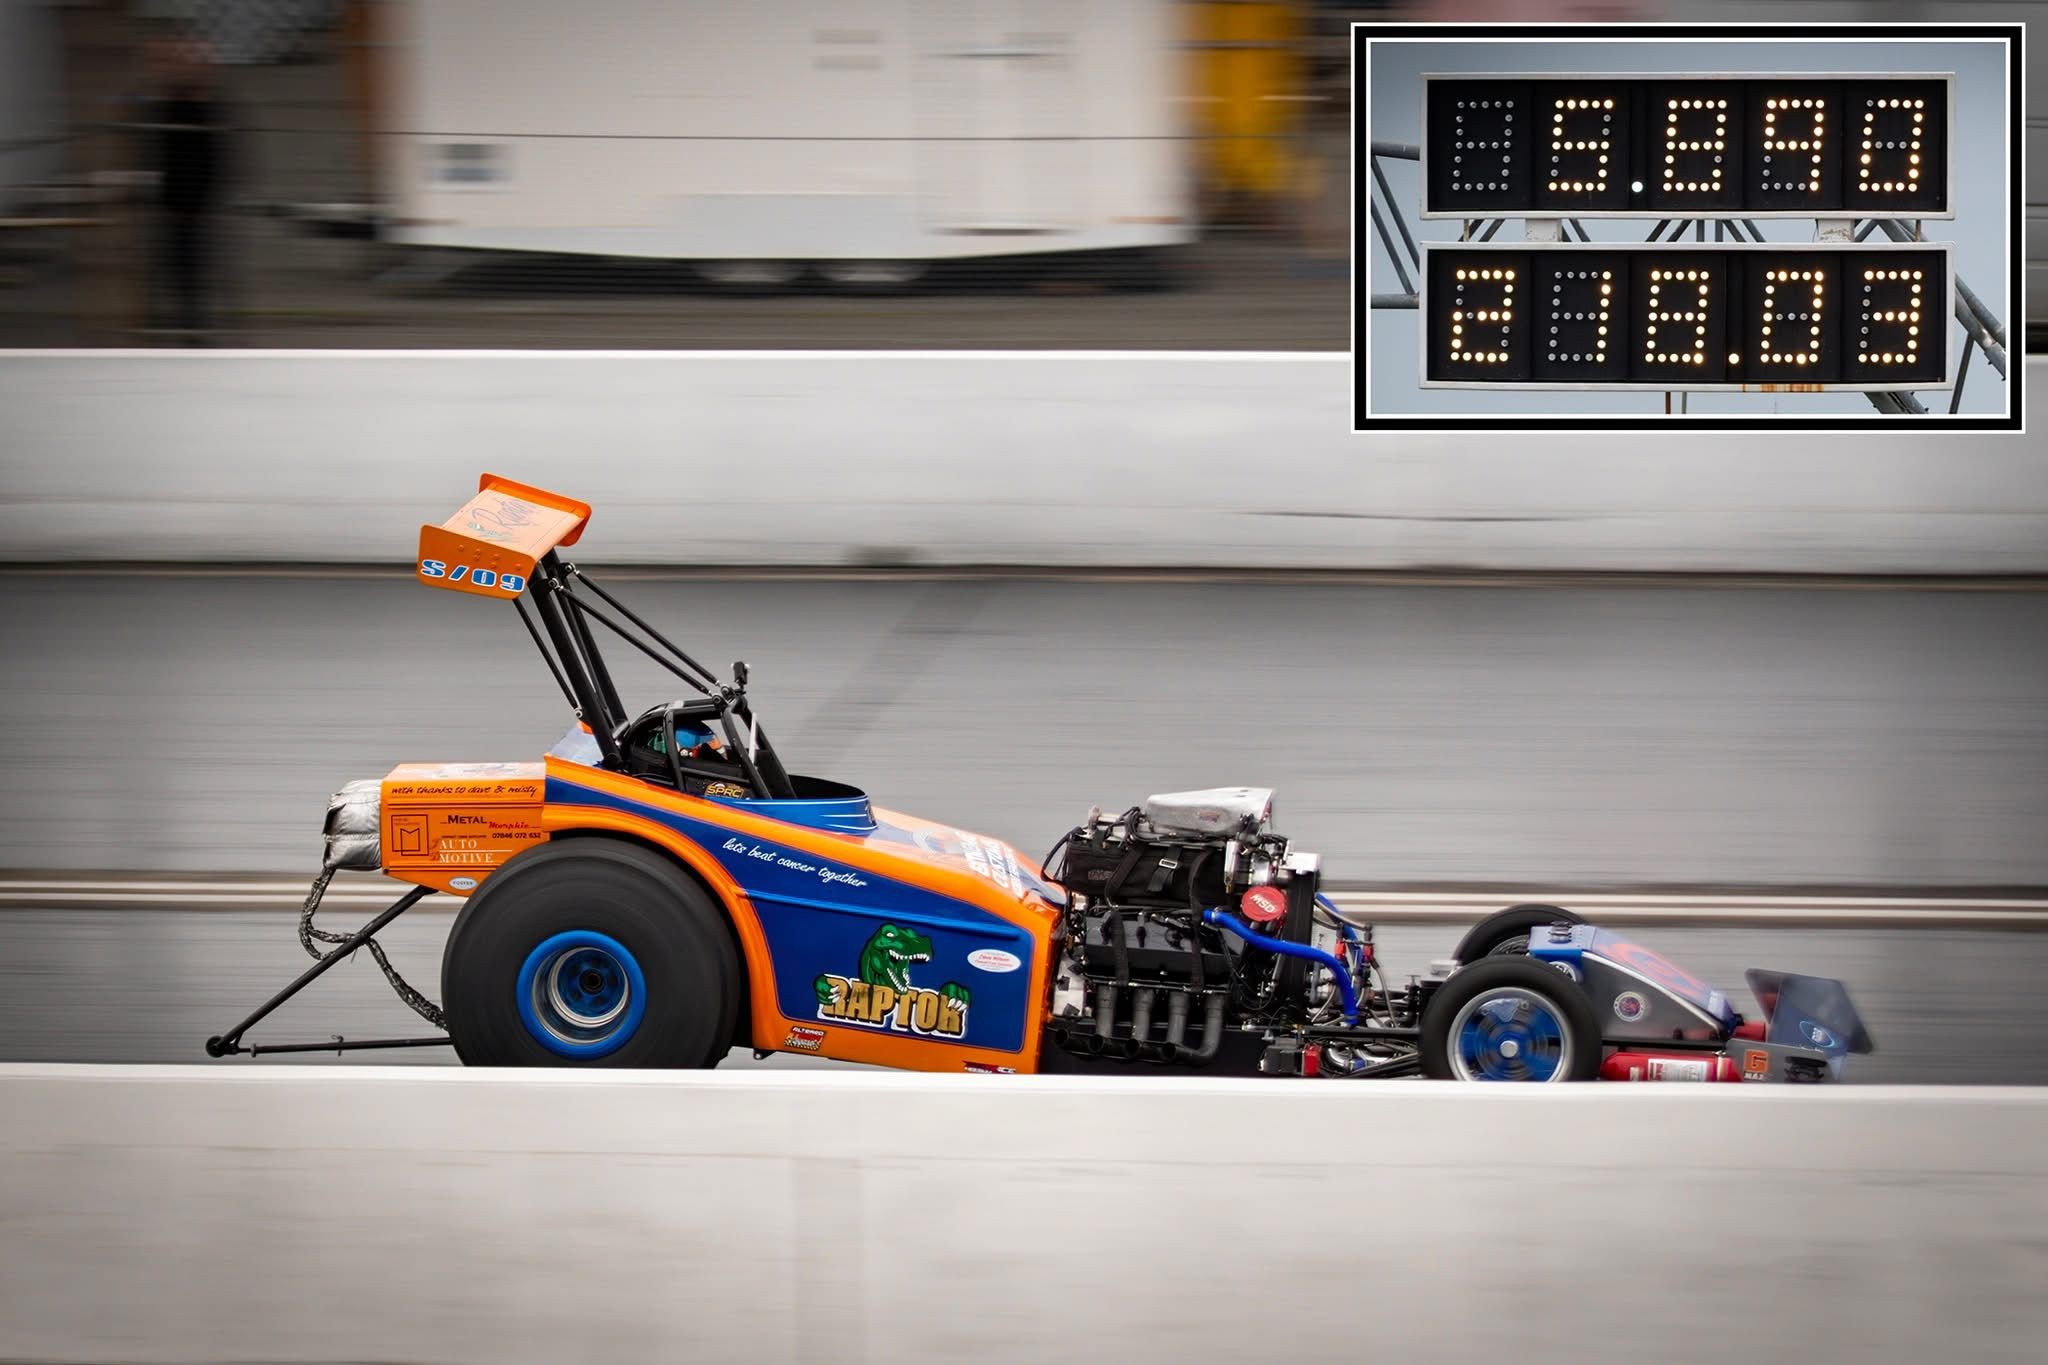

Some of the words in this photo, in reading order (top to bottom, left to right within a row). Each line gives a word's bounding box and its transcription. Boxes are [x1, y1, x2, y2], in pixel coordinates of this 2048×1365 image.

[1548, 99, 1924, 192] 5.890
[1450, 270, 1922, 363] 218.03
[421, 559, 525, 592] S/09
[391, 785, 414, 795] with
[416, 785, 454, 795] thanks
[455, 785, 467, 794] to
[468, 785, 492, 794] dave
[494, 785, 505, 794] &
[440, 839, 478, 849] AUTO
[440, 853, 494, 863] MOTIVE
[747, 845, 777, 862] beat
[777, 857, 816, 872] cancer
[817, 866, 868, 887] together
[1250, 893, 1276, 913] MSD
[820, 975, 965, 1037] RAPTOR
